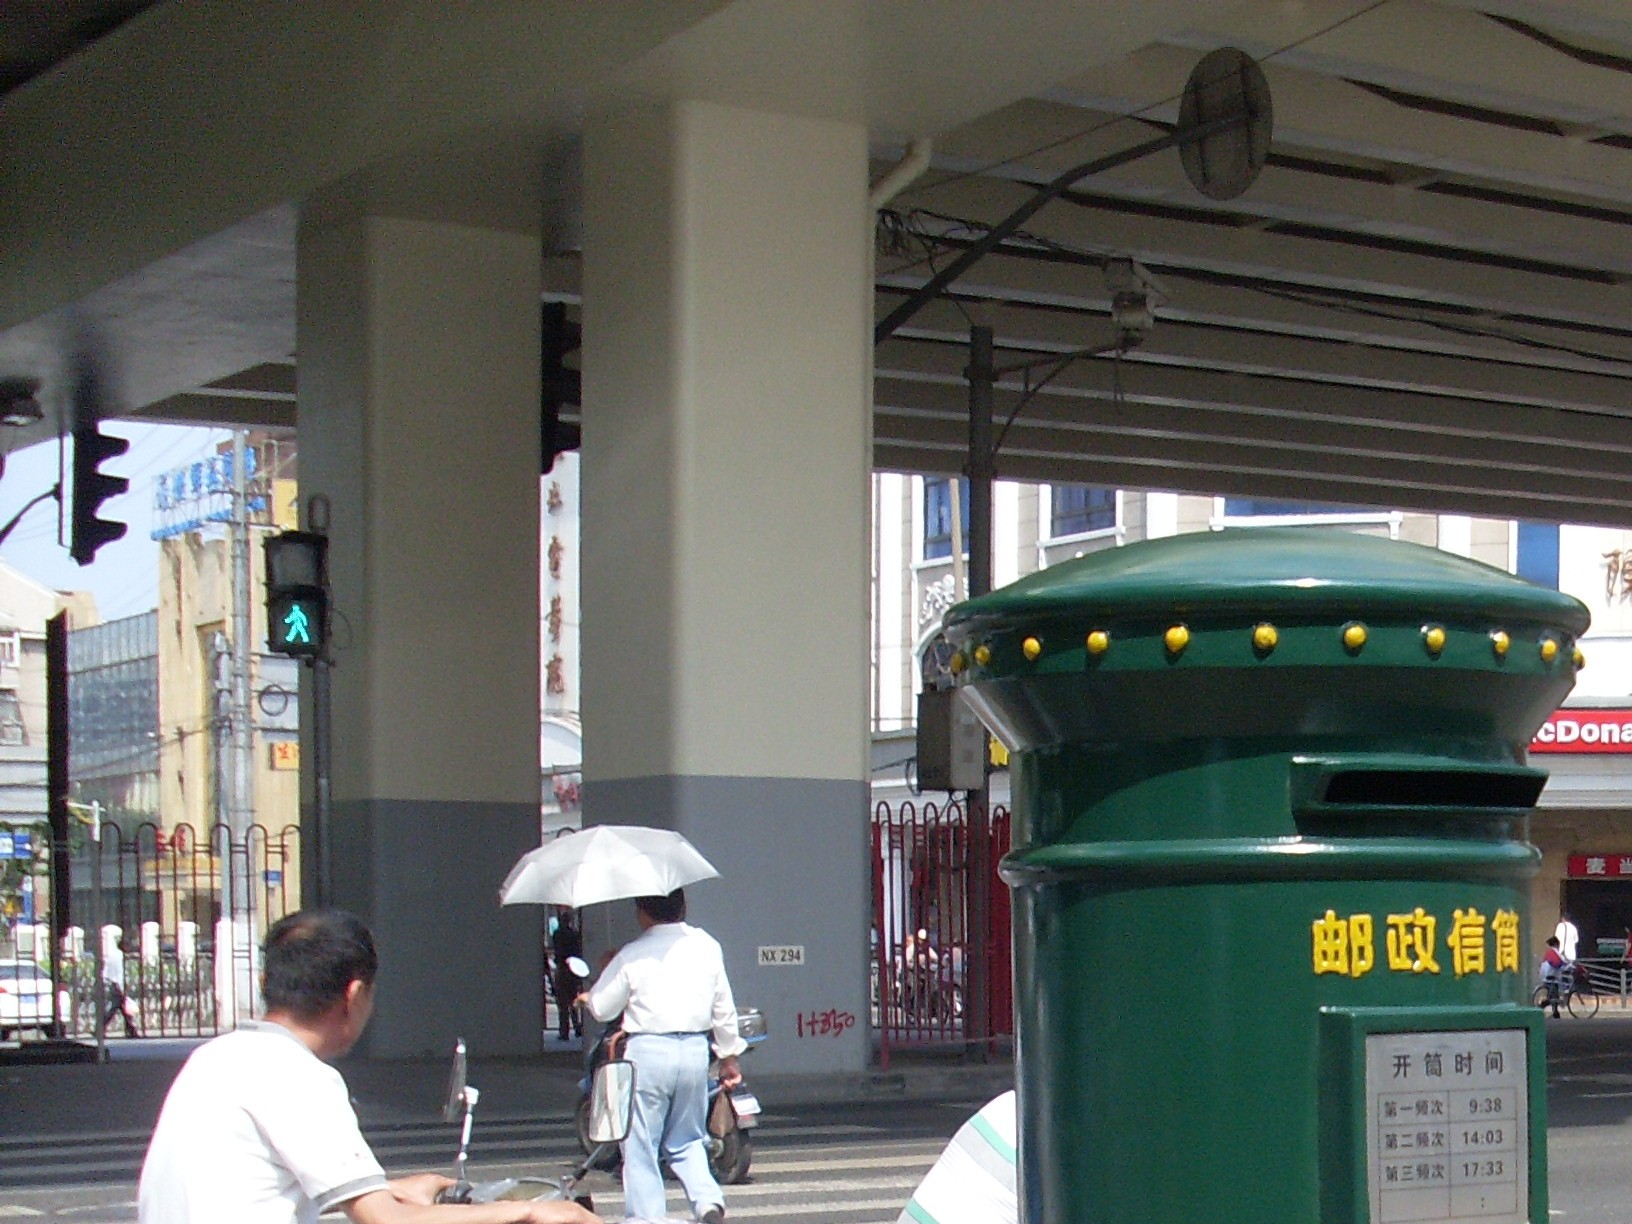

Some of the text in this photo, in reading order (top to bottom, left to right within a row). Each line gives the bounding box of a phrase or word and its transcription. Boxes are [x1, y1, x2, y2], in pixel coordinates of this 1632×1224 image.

[1312, 907, 1520, 979] 邮政信筒
[761, 949, 801, 963] NX 294
[1393, 1051, 1504, 1079] 开筒时间
[1469, 1098, 1503, 1114] 9:38
[1463, 1129, 1504, 1145] 14:03
[1463, 1161, 1504, 1178] 17:33
